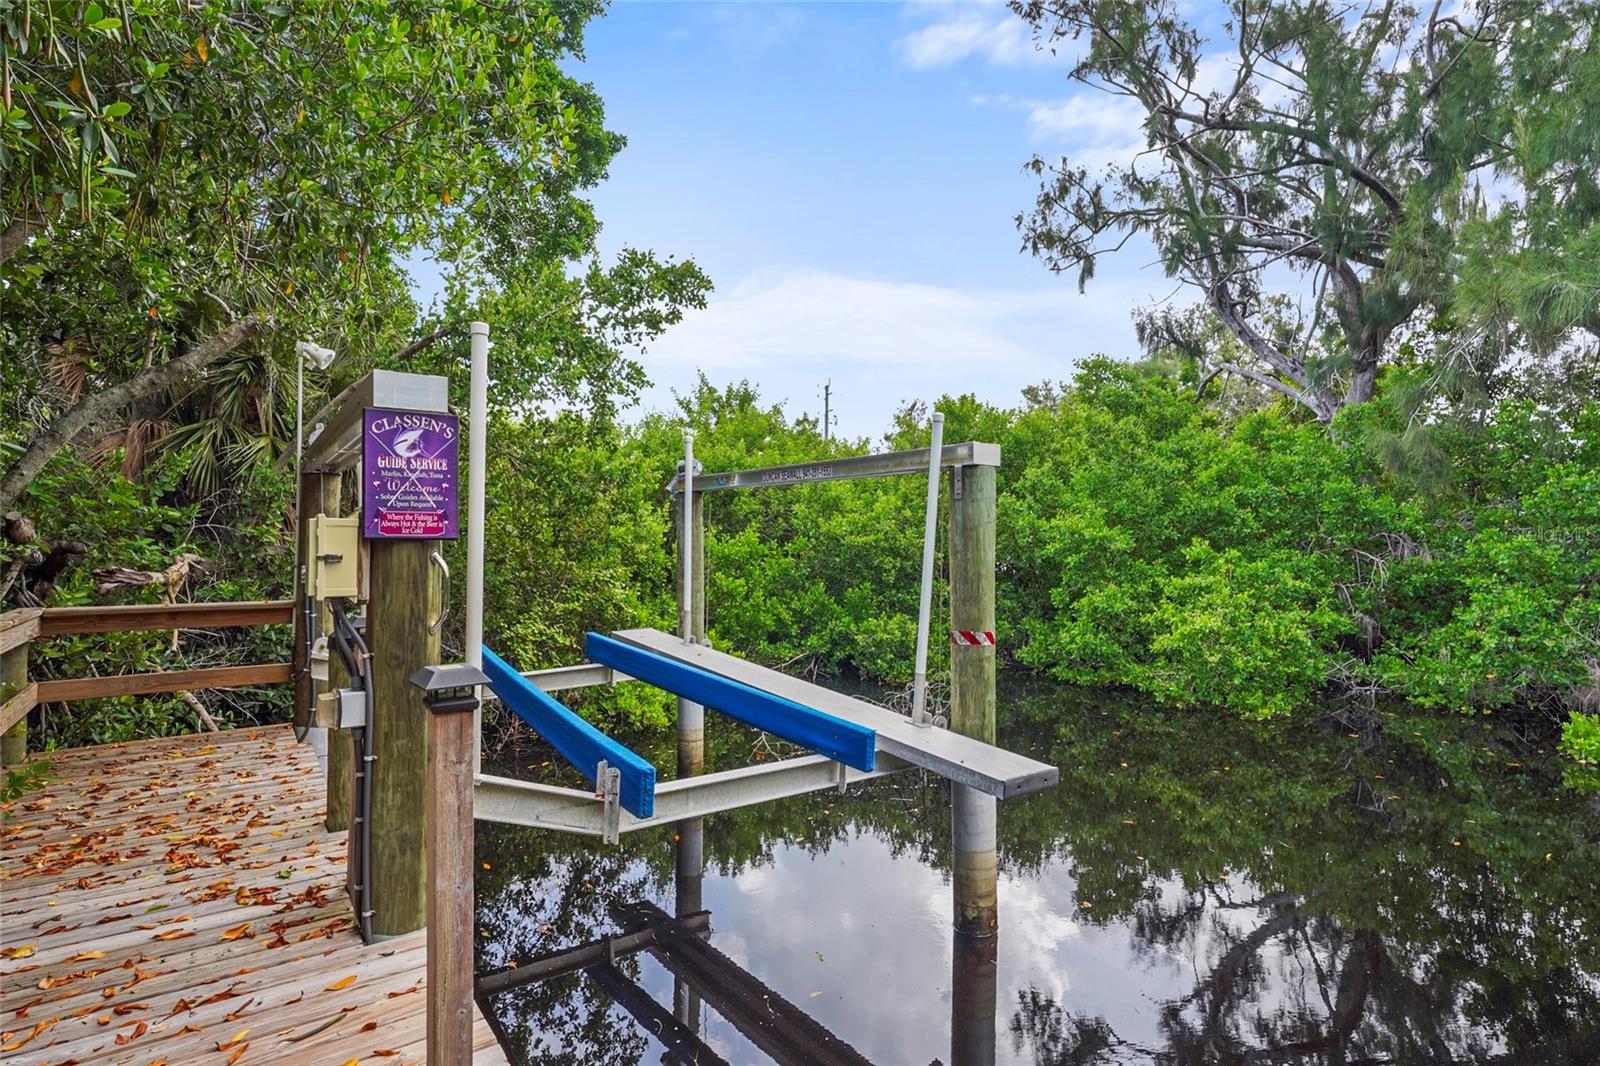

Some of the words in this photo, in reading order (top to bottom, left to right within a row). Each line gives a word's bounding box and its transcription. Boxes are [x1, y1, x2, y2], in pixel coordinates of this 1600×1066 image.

[371, 415, 454, 439] CLASSEN'S
[377, 455, 408, 469] GUIDE
[410, 457, 447, 470] SERVICE
[387, 513, 403, 521] Where
[414, 514, 434, 522] Fishing
[381, 521, 399, 529] Always
